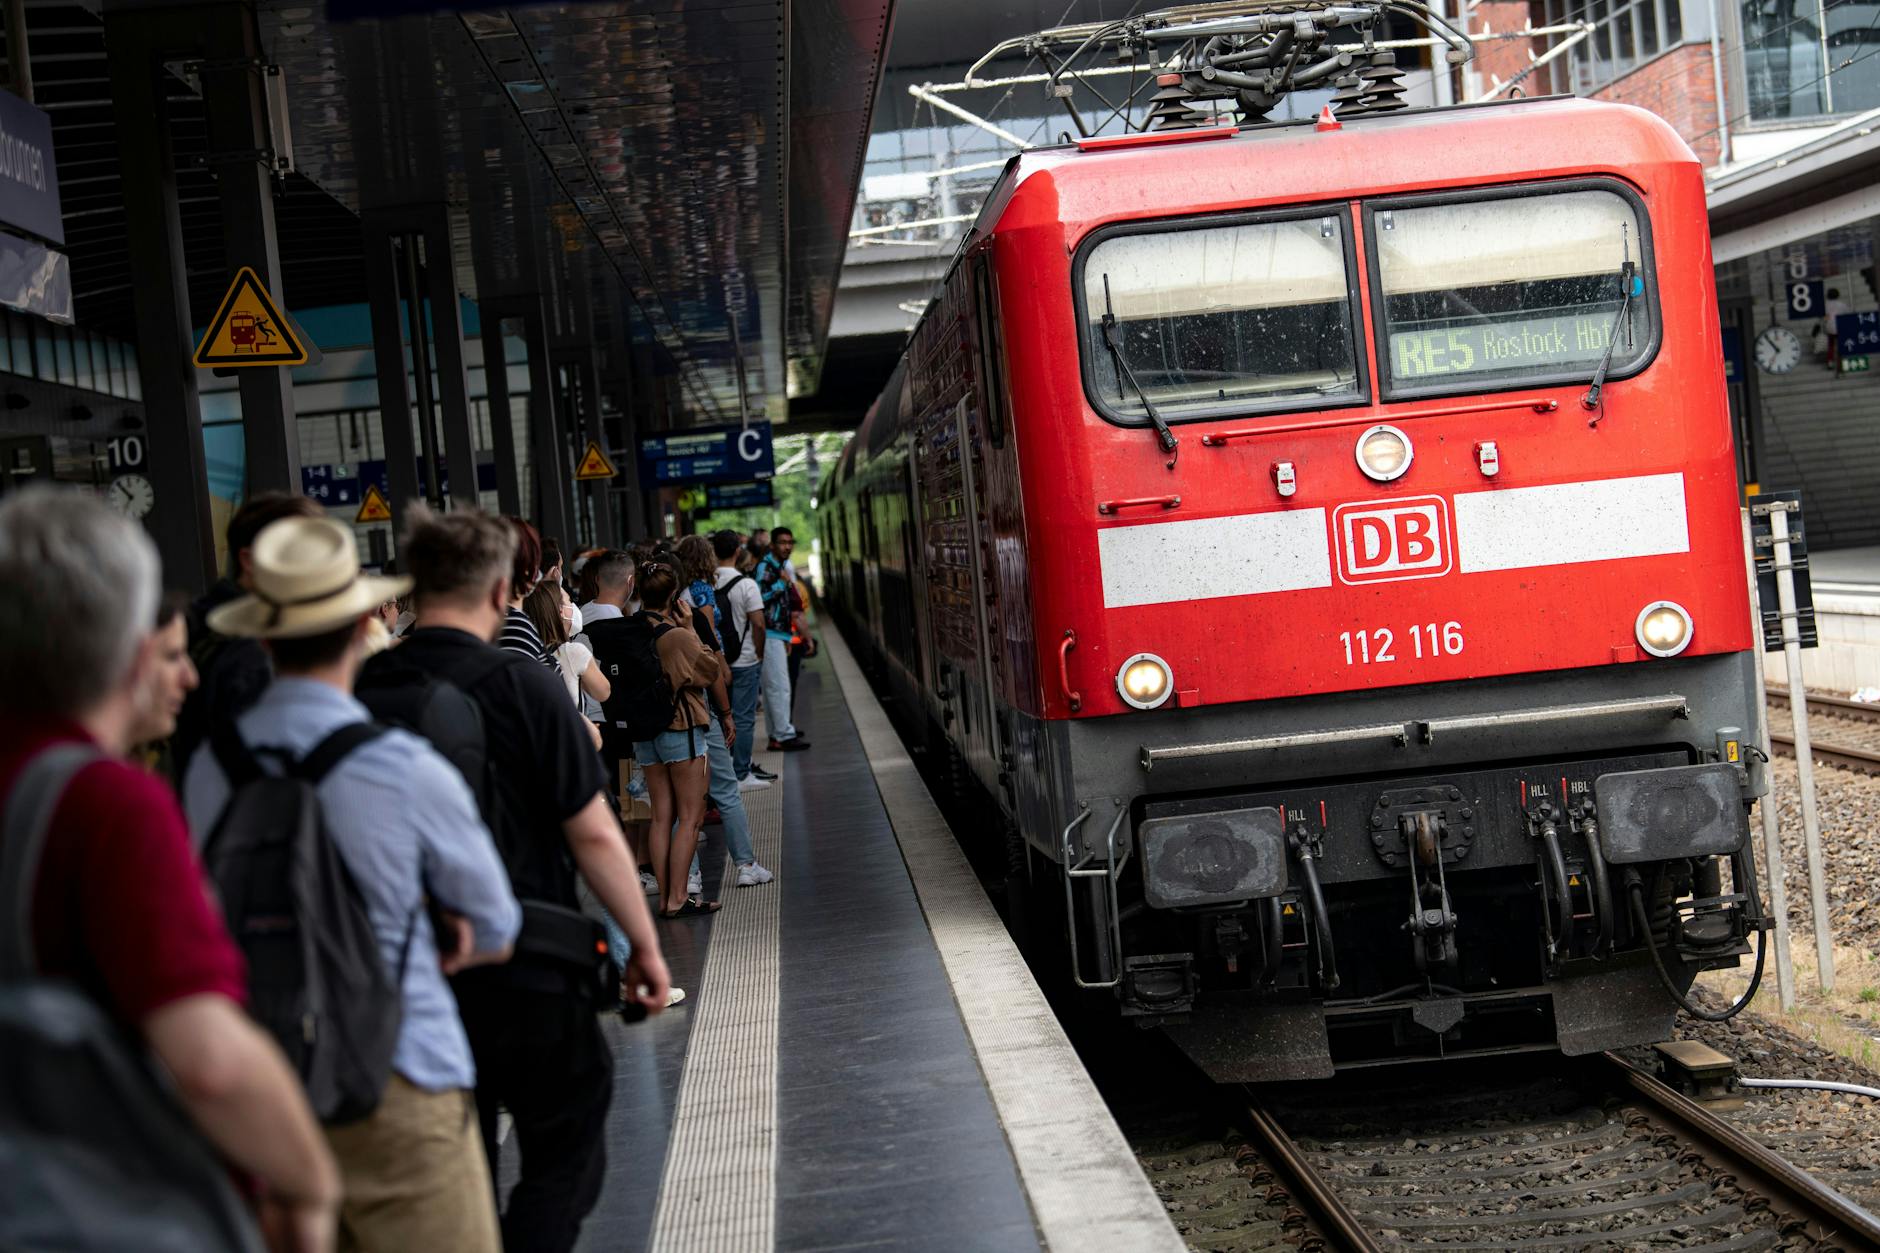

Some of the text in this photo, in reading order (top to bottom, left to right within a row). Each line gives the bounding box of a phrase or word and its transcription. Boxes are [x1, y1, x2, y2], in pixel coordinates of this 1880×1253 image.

[0, 116, 46, 192] brunnen
[1792, 283, 1811, 312] 8
[1397, 328, 1474, 377] RE5
[1483, 321, 1568, 361] Rostock
[108, 437, 142, 467] 10
[738, 429, 763, 462] C
[1351, 512, 1435, 569] DB
[1339, 621, 1464, 665] 112 116
[1531, 784, 1549, 798] HLL
[1571, 781, 1590, 794] HBL
[1288, 809, 1306, 822] HLL
